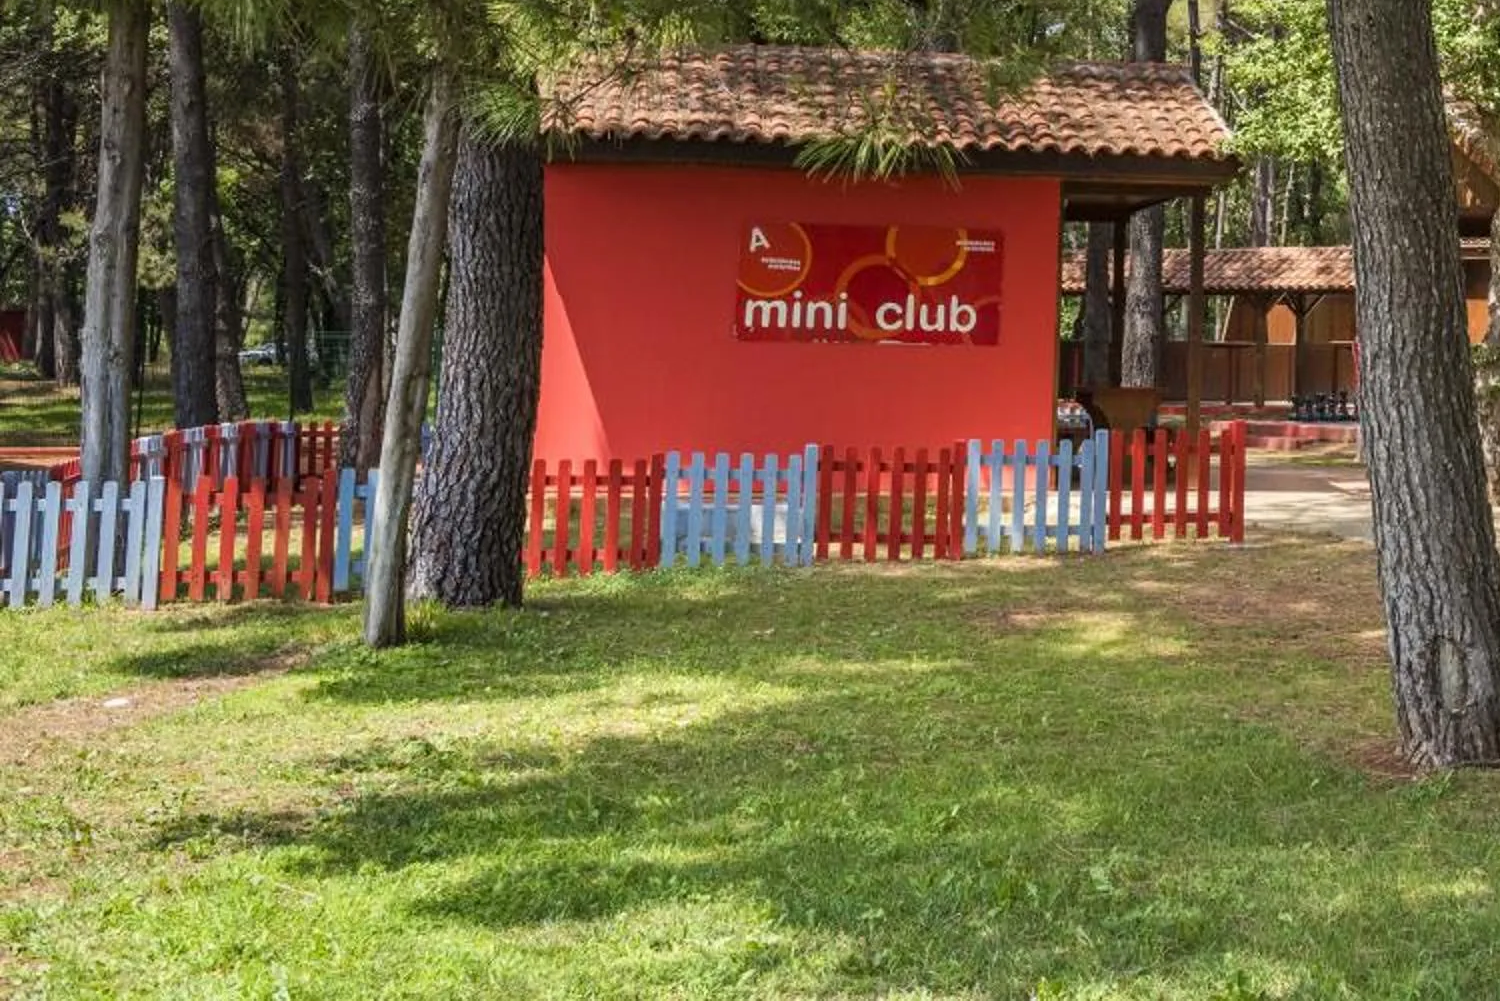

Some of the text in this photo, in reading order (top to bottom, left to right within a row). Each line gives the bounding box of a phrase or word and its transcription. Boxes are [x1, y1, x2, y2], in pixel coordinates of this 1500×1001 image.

[749, 227, 771, 252] A
[745, 290, 977, 332] mini club
